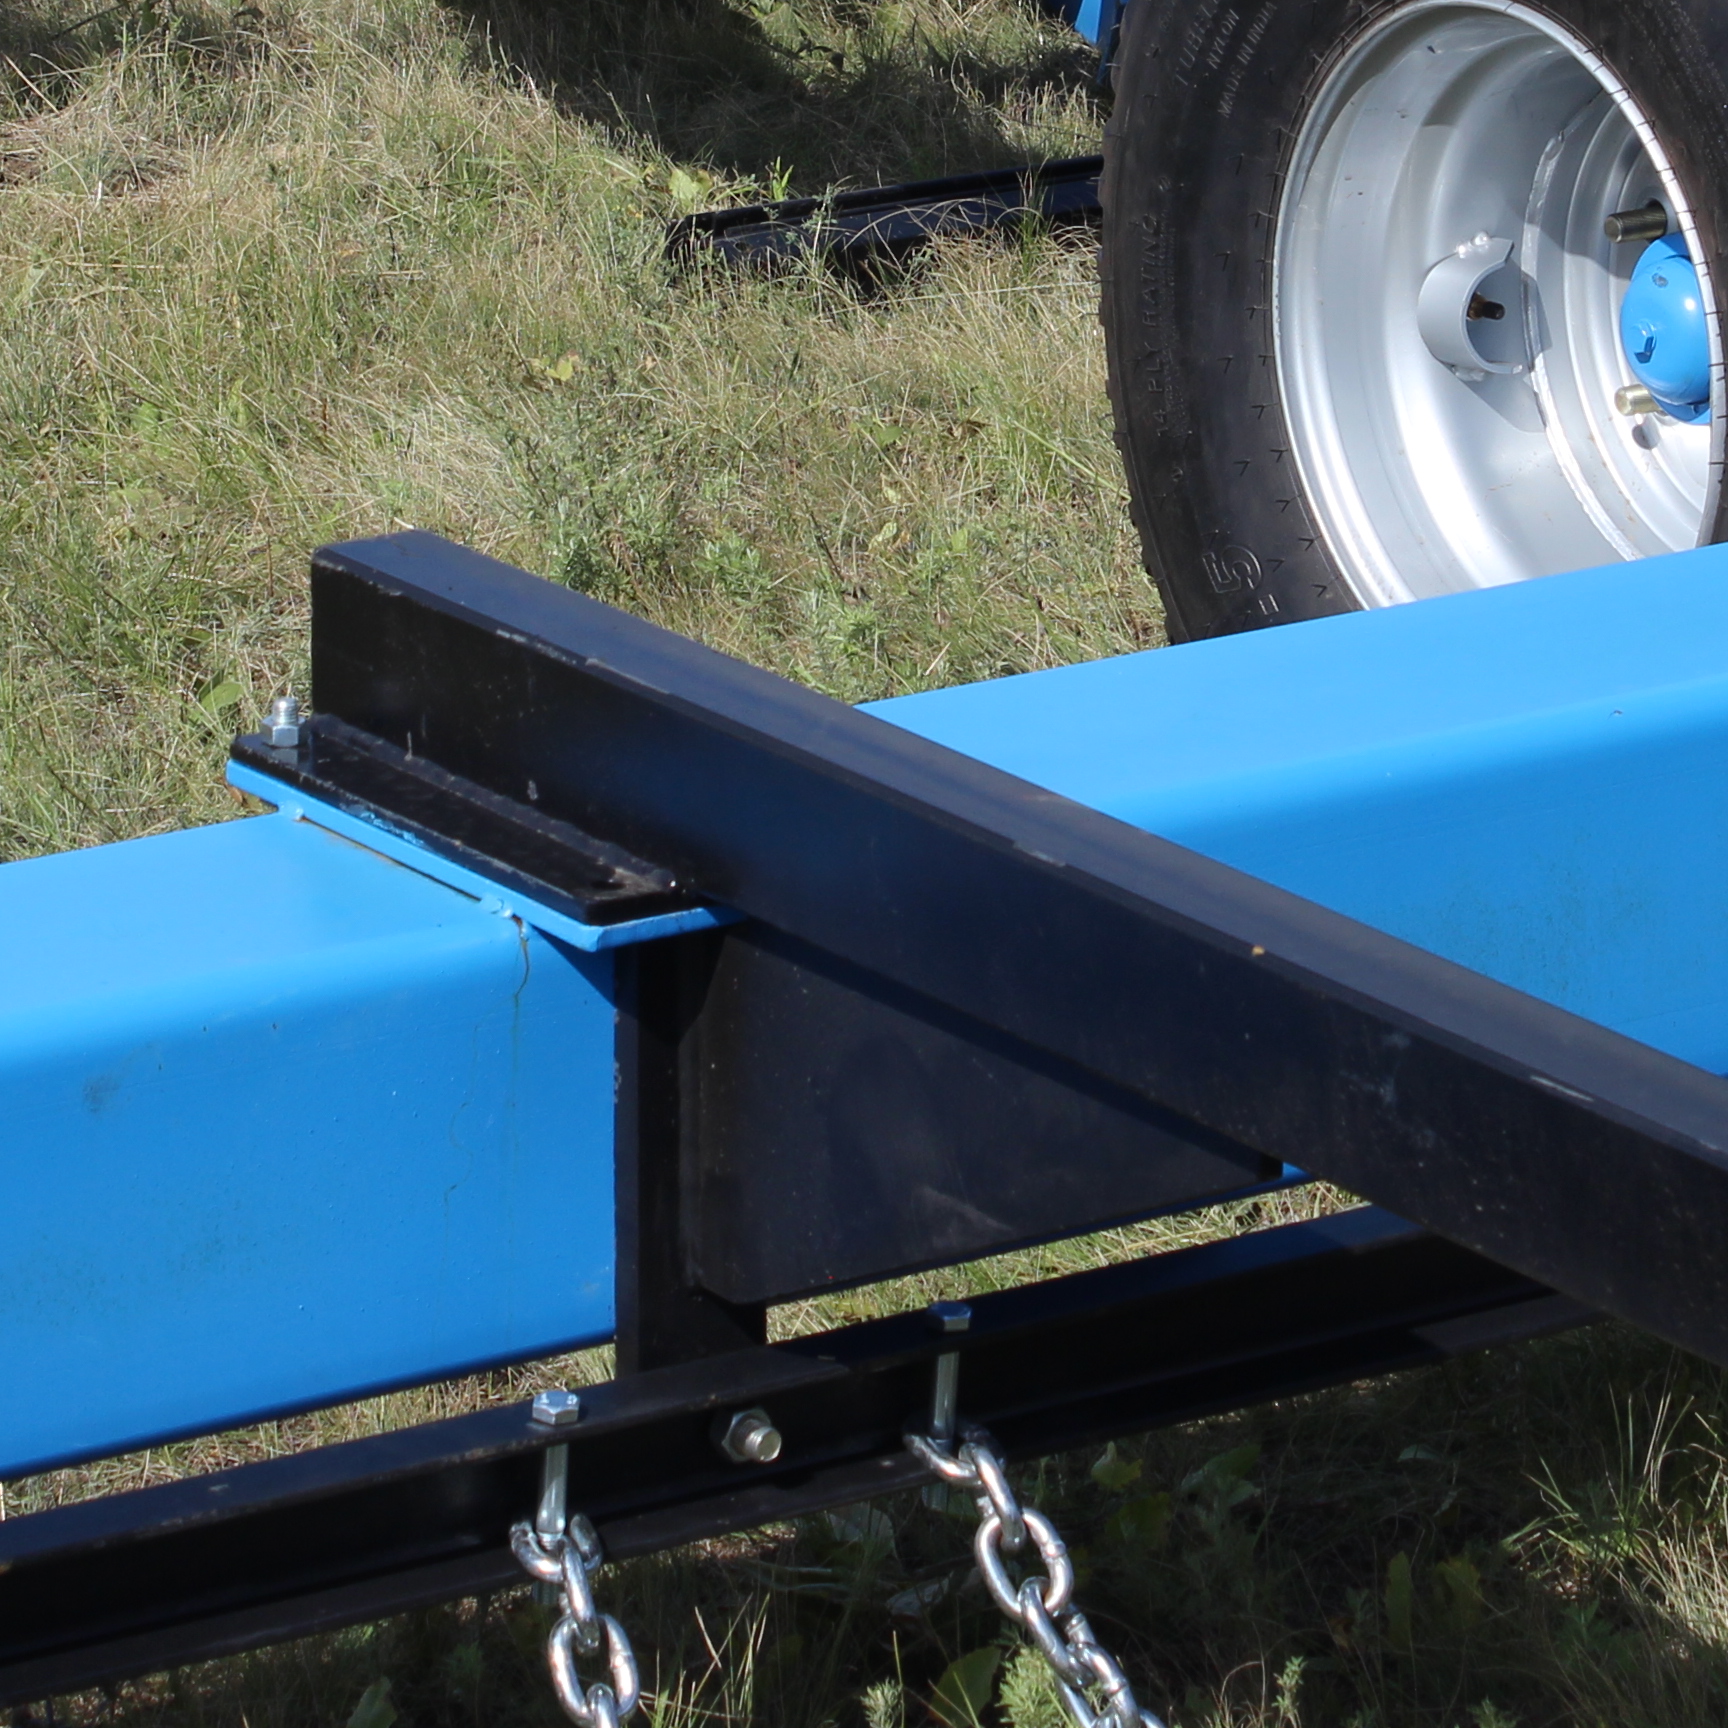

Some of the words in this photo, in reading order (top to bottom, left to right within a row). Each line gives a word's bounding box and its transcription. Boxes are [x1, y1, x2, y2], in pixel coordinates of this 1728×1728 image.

[1205, 8, 1241, 70] NYLON
[1217, 64, 1246, 119] MADE
[1235, 43, 1256, 66] IN
[1246, 0, 1279, 45] INDIA
[1140, 211, 1160, 327] RATING
[1144, 340, 1164, 394] PLY
[1154, 409, 1168, 437] 14
